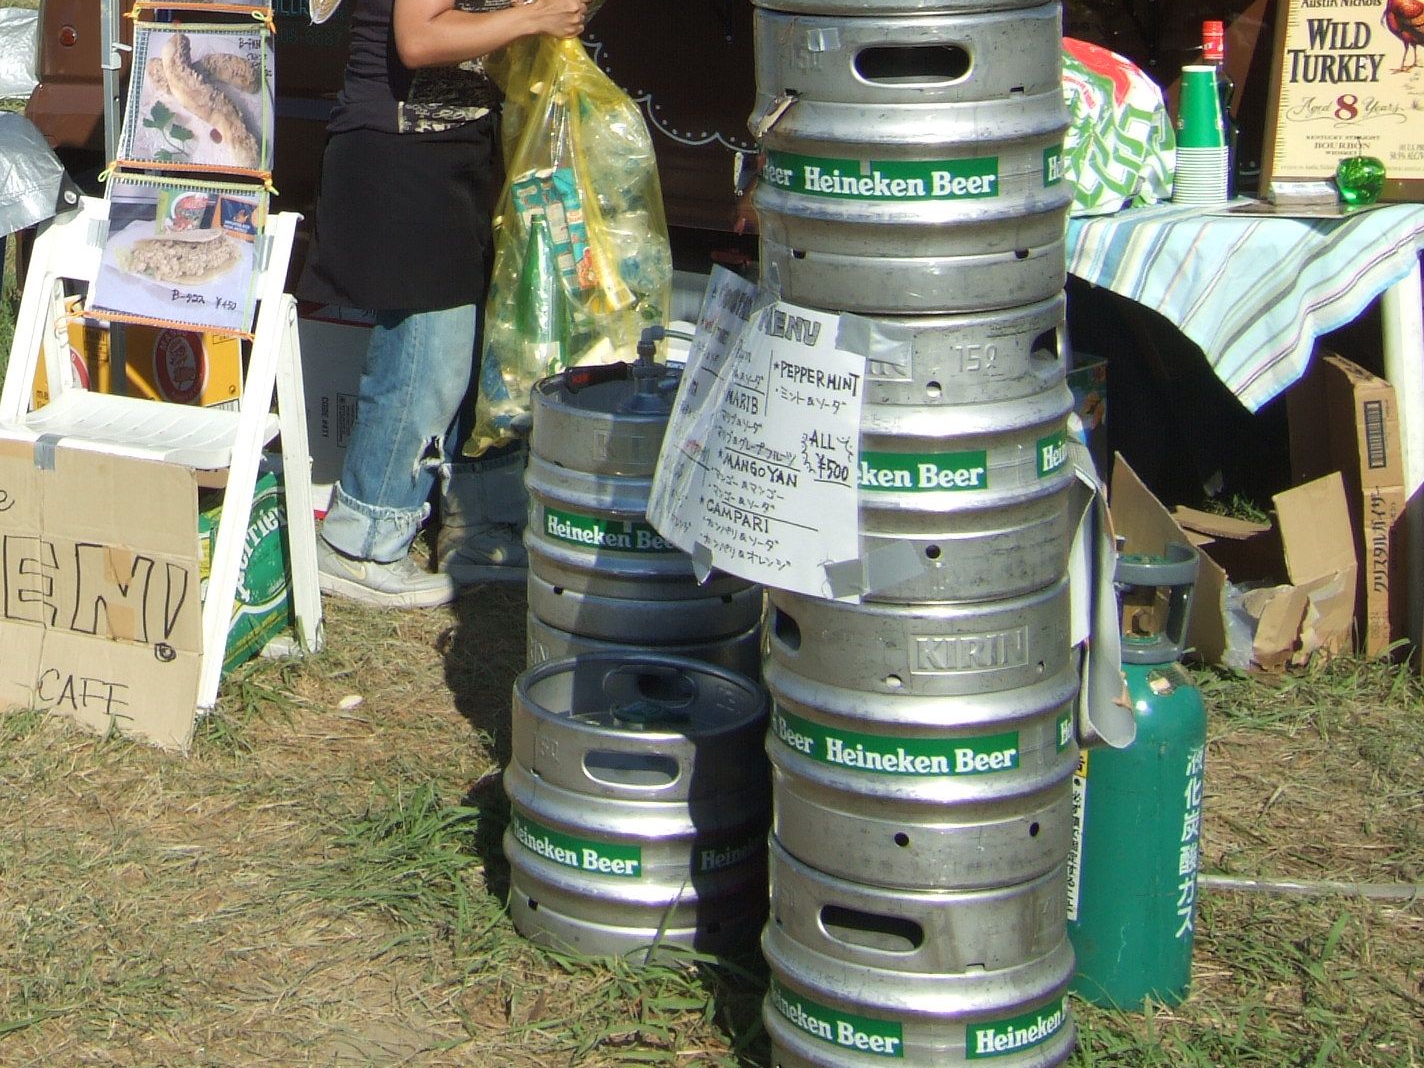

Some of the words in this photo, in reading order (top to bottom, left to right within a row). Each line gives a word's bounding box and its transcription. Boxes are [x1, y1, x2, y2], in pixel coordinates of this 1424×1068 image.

[1307, 18, 1372, 51] WILD
[1287, 49, 1386, 84] TURKEY
[1334, 93, 1359, 121] 8
[803, 165, 926, 197] Heineken
[930, 171, 996, 197] Beer
[780, 359, 861, 397] PEPPERMINT
[809, 429, 836, 451] ALL
[815, 452, 850, 482] ¥500
[918, 458, 984, 489] Beer
[546, 513, 632, 549] Heineken
[705, 498, 770, 534] CAMPARI
[37, 668, 135, 721] CAFE
[825, 737, 949, 774] Heineken
[954, 746, 1018, 773] Beer
[581, 847, 640, 876] Beer
[836, 1020, 900, 1055] Beer
[974, 1011, 1061, 1054] Heineken
